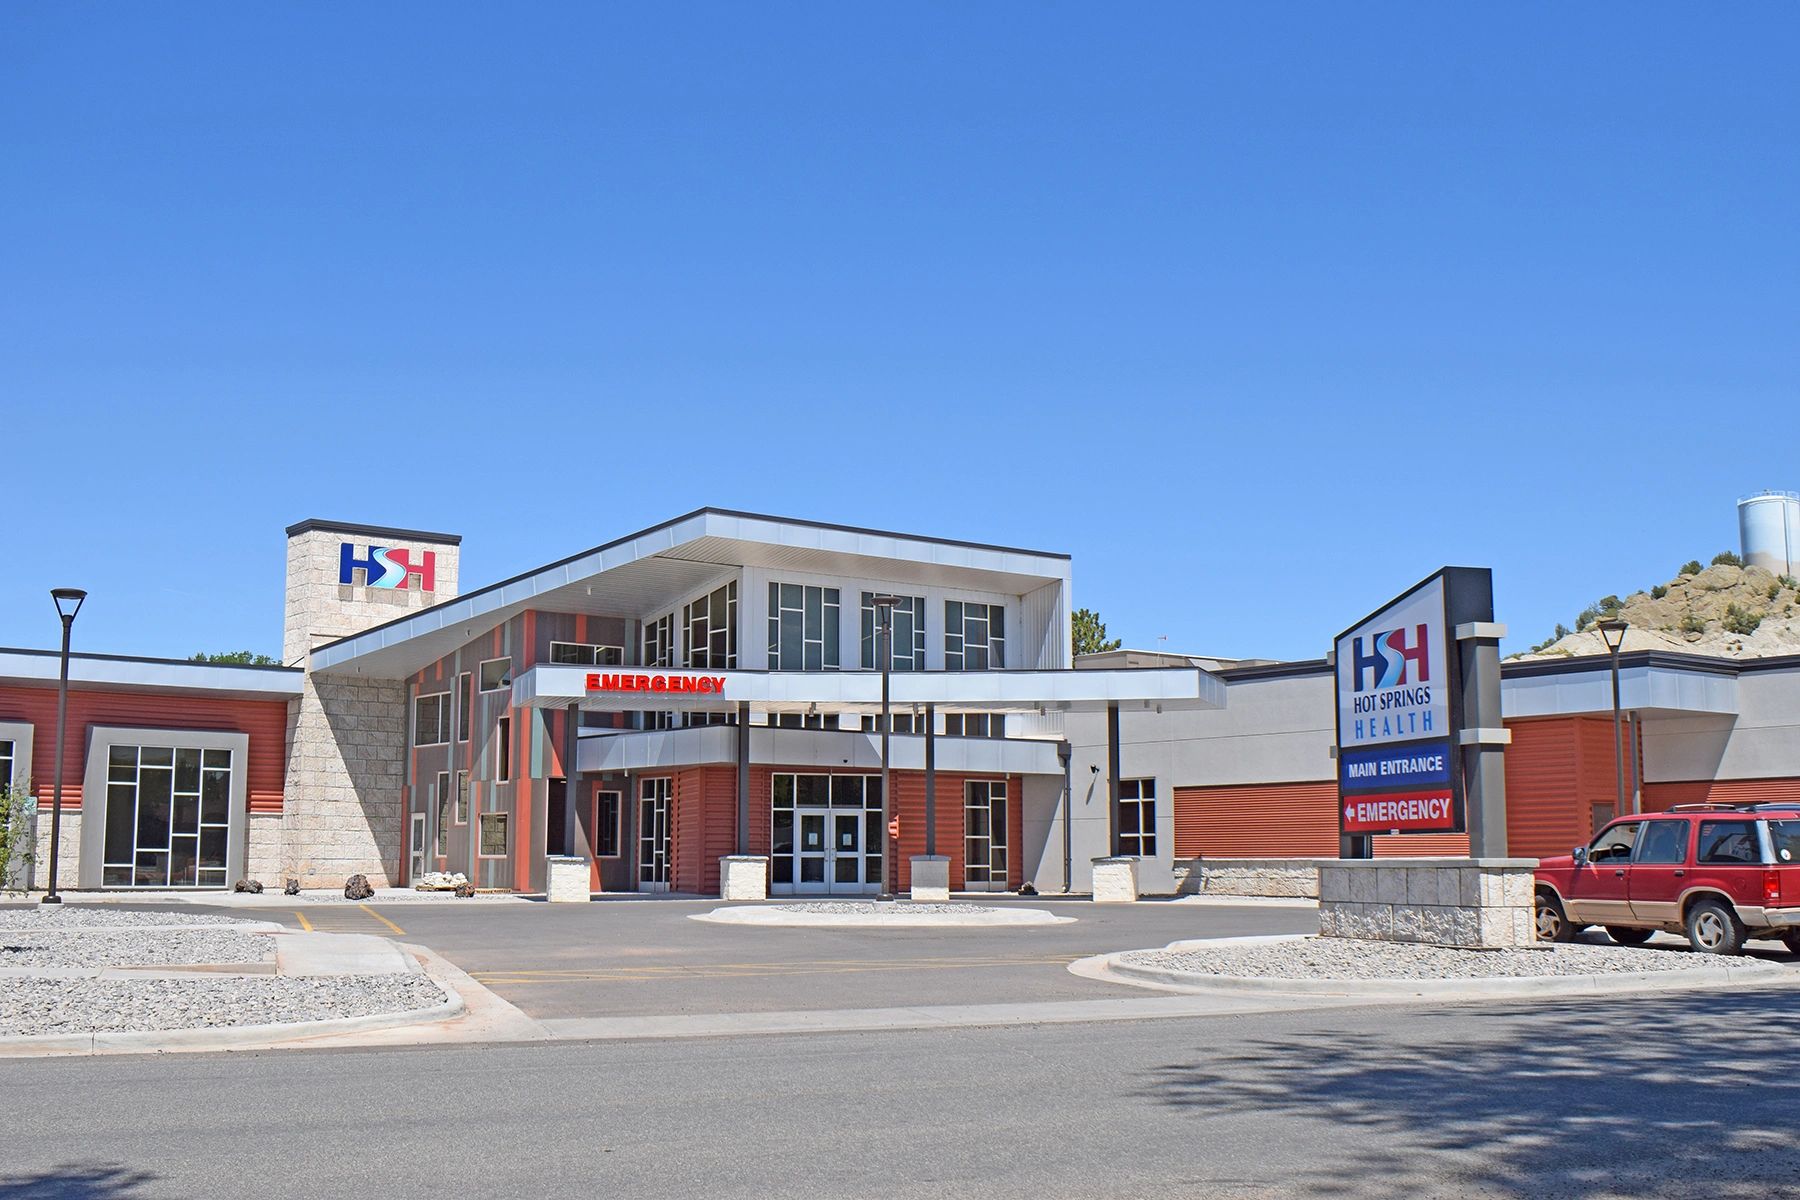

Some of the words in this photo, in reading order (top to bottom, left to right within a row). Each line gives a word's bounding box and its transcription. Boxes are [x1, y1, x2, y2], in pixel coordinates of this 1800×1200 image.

[339, 542, 436, 592] HSH
[1353, 623, 1430, 692] HSH
[586, 673, 726, 694] EMERGENCY
[1354, 694, 1377, 714] HOT
[1380, 686, 1431, 710] SPRINGS
[1355, 710, 1433, 739] HEALTH
[1349, 761, 1377, 778] MAIN
[1380, 756, 1443, 776] ENTRANCE
[1357, 798, 1450, 822] EMERGENCY
